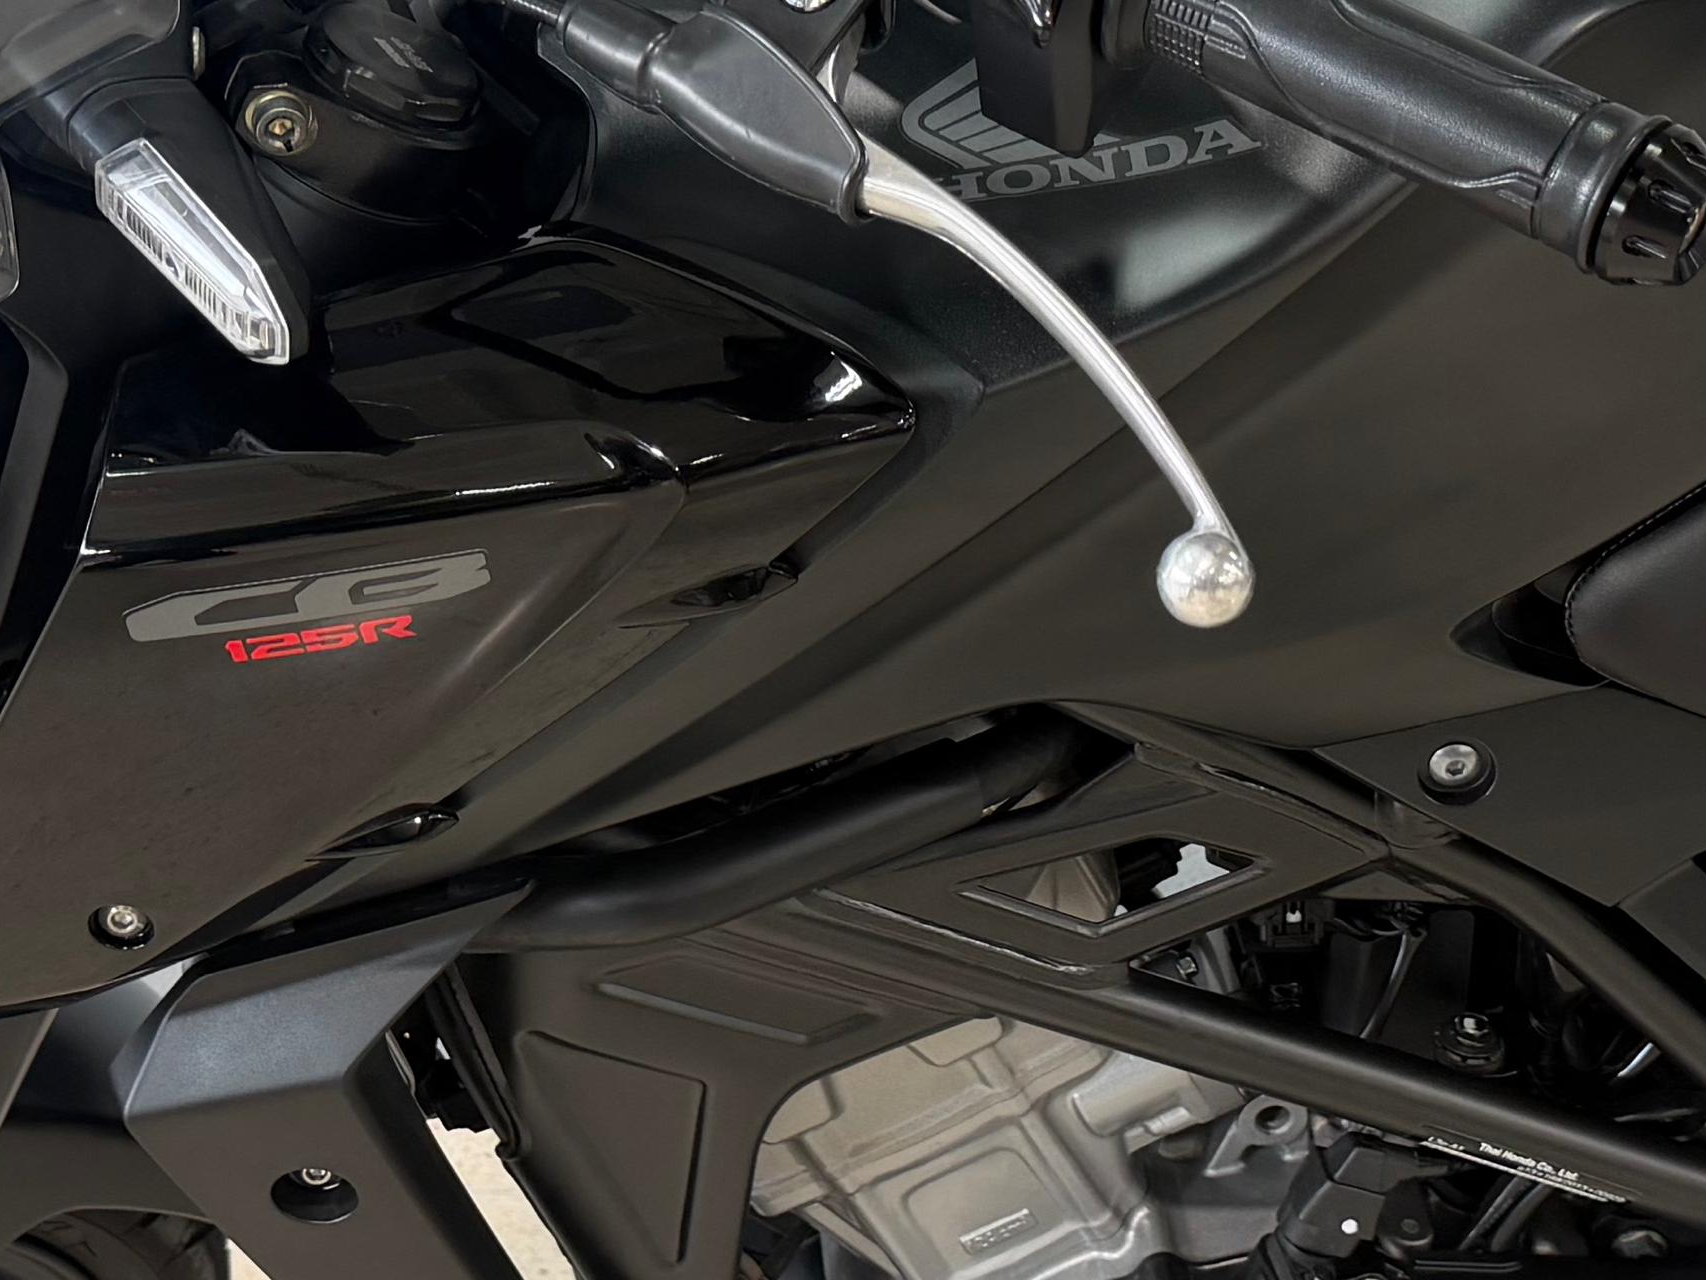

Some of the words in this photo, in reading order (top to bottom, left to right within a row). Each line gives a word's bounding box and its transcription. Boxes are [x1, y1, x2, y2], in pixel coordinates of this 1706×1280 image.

[123, 548, 491, 642] CB
[225, 614, 416, 663] 125R
[1479, 1142, 1502, 1157] Thai
[1501, 1150, 1537, 1168] Honda
